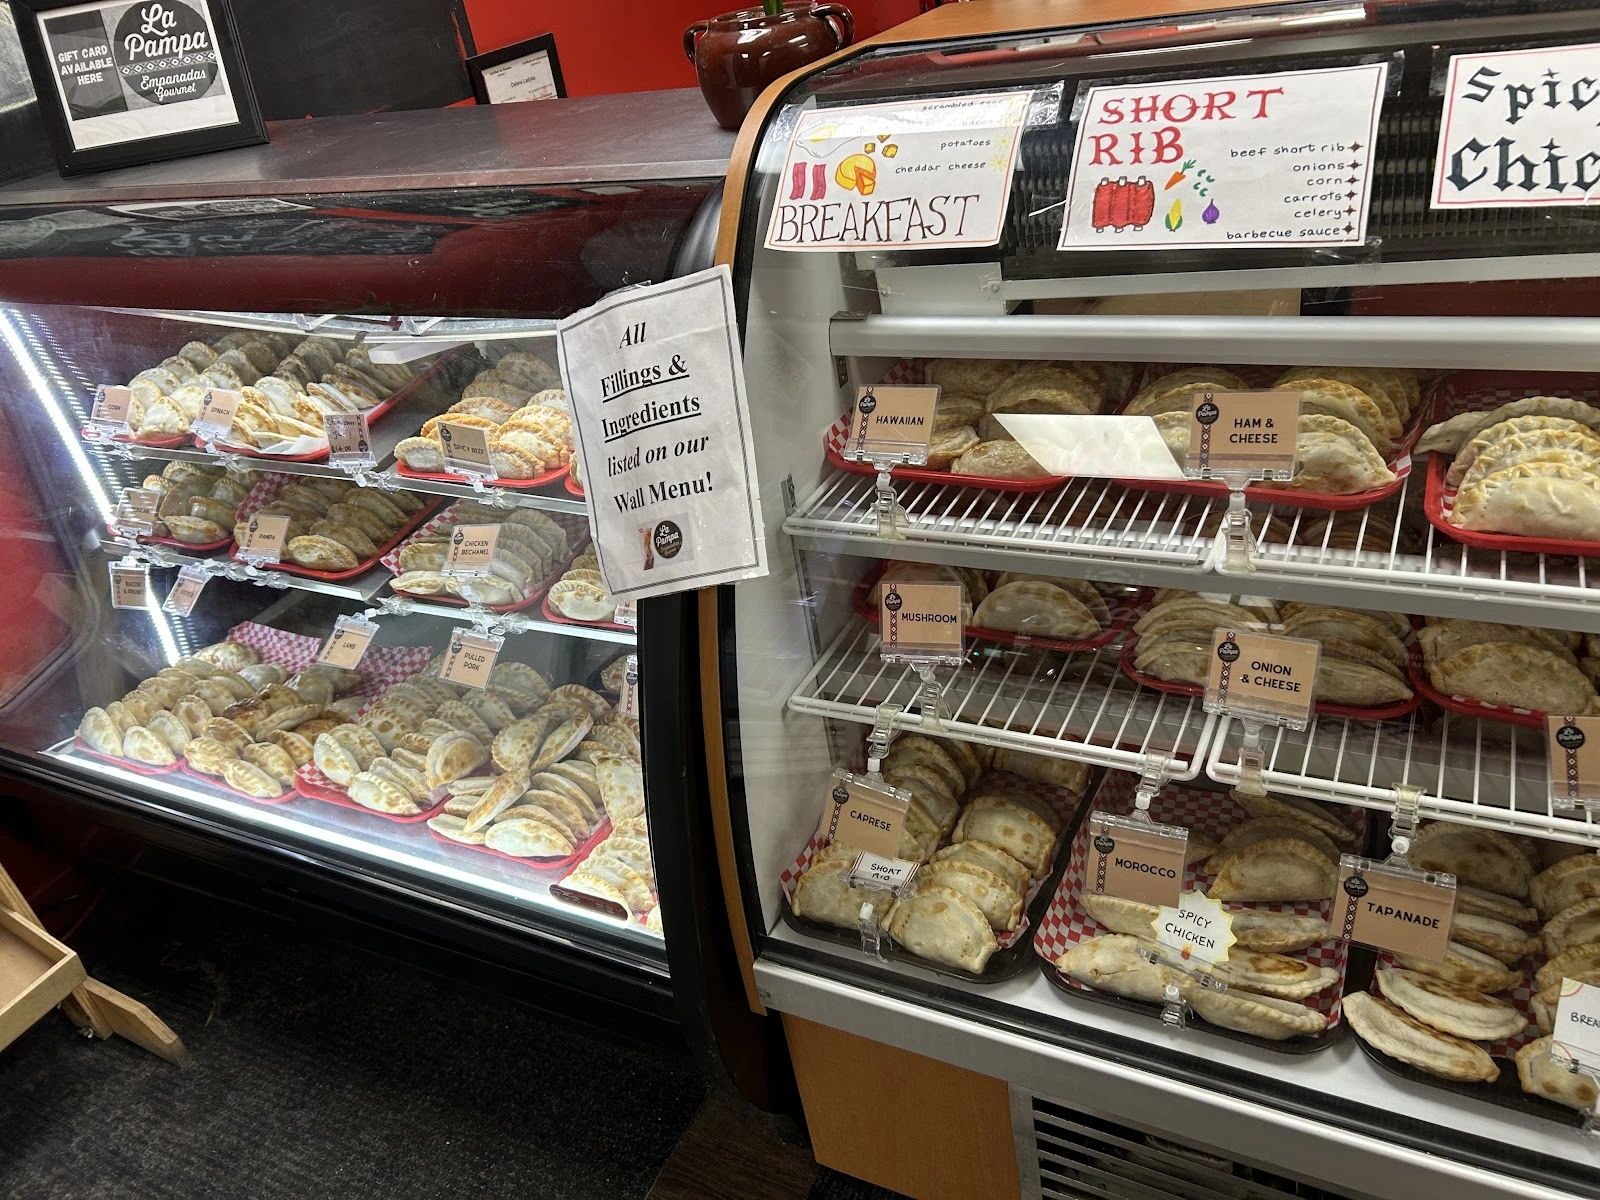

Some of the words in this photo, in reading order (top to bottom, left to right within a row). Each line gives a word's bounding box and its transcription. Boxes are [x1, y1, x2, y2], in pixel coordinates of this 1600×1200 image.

[140, 3, 177, 36] La
[124, 30, 208, 61] Pampa
[58, 50, 79, 63] GIFT
[82, 45, 108, 58] CARD
[61, 57, 113, 76] AVAILABLE
[77, 72, 103, 86] HERE
[140, 69, 206, 91] Empanadas
[154, 83, 196, 101] Gourmet
[1461, 66, 1600, 125] Spic
[922, 101, 973, 111] scrambled
[1098, 87, 1284, 125] SHORT
[941, 138, 991, 150] potatoes
[1088, 126, 1184, 166] RIB
[1230, 147, 1267, 158] beef
[1273, 143, 1315, 155] short
[1321, 142, 1345, 153] rib
[895, 163, 940, 174] cheddar
[948, 159, 986, 172] cheese
[1292, 161, 1345, 173] onions
[1446, 136, 1600, 193] Chic
[1306, 177, 1343, 187] corn
[1284, 191, 1342, 204] carrots
[775, 193, 979, 244] BREAKFAST
[1293, 207, 1343, 220] celery
[1227, 228, 1292, 240] barbecue
[1299, 226, 1340, 237] sauce
[619, 322, 647, 349] All
[600, 364, 662, 399] Fillings
[668, 354, 688, 376] &
[210, 407, 231, 416] SPINACH
[601, 395, 700, 438] Ingredients
[876, 415, 924, 426] HAWAIIAN
[1234, 418, 1261, 428] HAM
[1265, 418, 1274, 428] &
[1229, 433, 1278, 444] CHEESE
[454, 443, 470, 452] SPICY
[607, 447, 640, 477] listed
[645, 448, 668, 464] on
[674, 435, 709, 457] our
[614, 487, 645, 514] Wall
[649, 471, 713, 505] Menu!
[659, 524, 670, 537] La
[655, 532, 679, 548] Pampa
[901, 612, 957, 623] MUSHROOM
[342, 641, 356, 649] LAMB
[464, 652, 485, 663] PULLED
[463, 661, 480, 671] PORK
[1251, 661, 1292, 676] ONION
[1241, 673, 1250, 684] &
[1254, 676, 1301, 692] CHEESE
[850, 810, 892, 832] CAPRESE
[870, 863, 901, 875] SHORT
[1115, 857, 1176, 879] MOROCCO
[1178, 909, 1212, 929] SPICY
[1367, 902, 1440, 929] TAPANADE
[1165, 922, 1215, 949] CHICKEN
[1571, 1012, 1600, 1028] BREA
